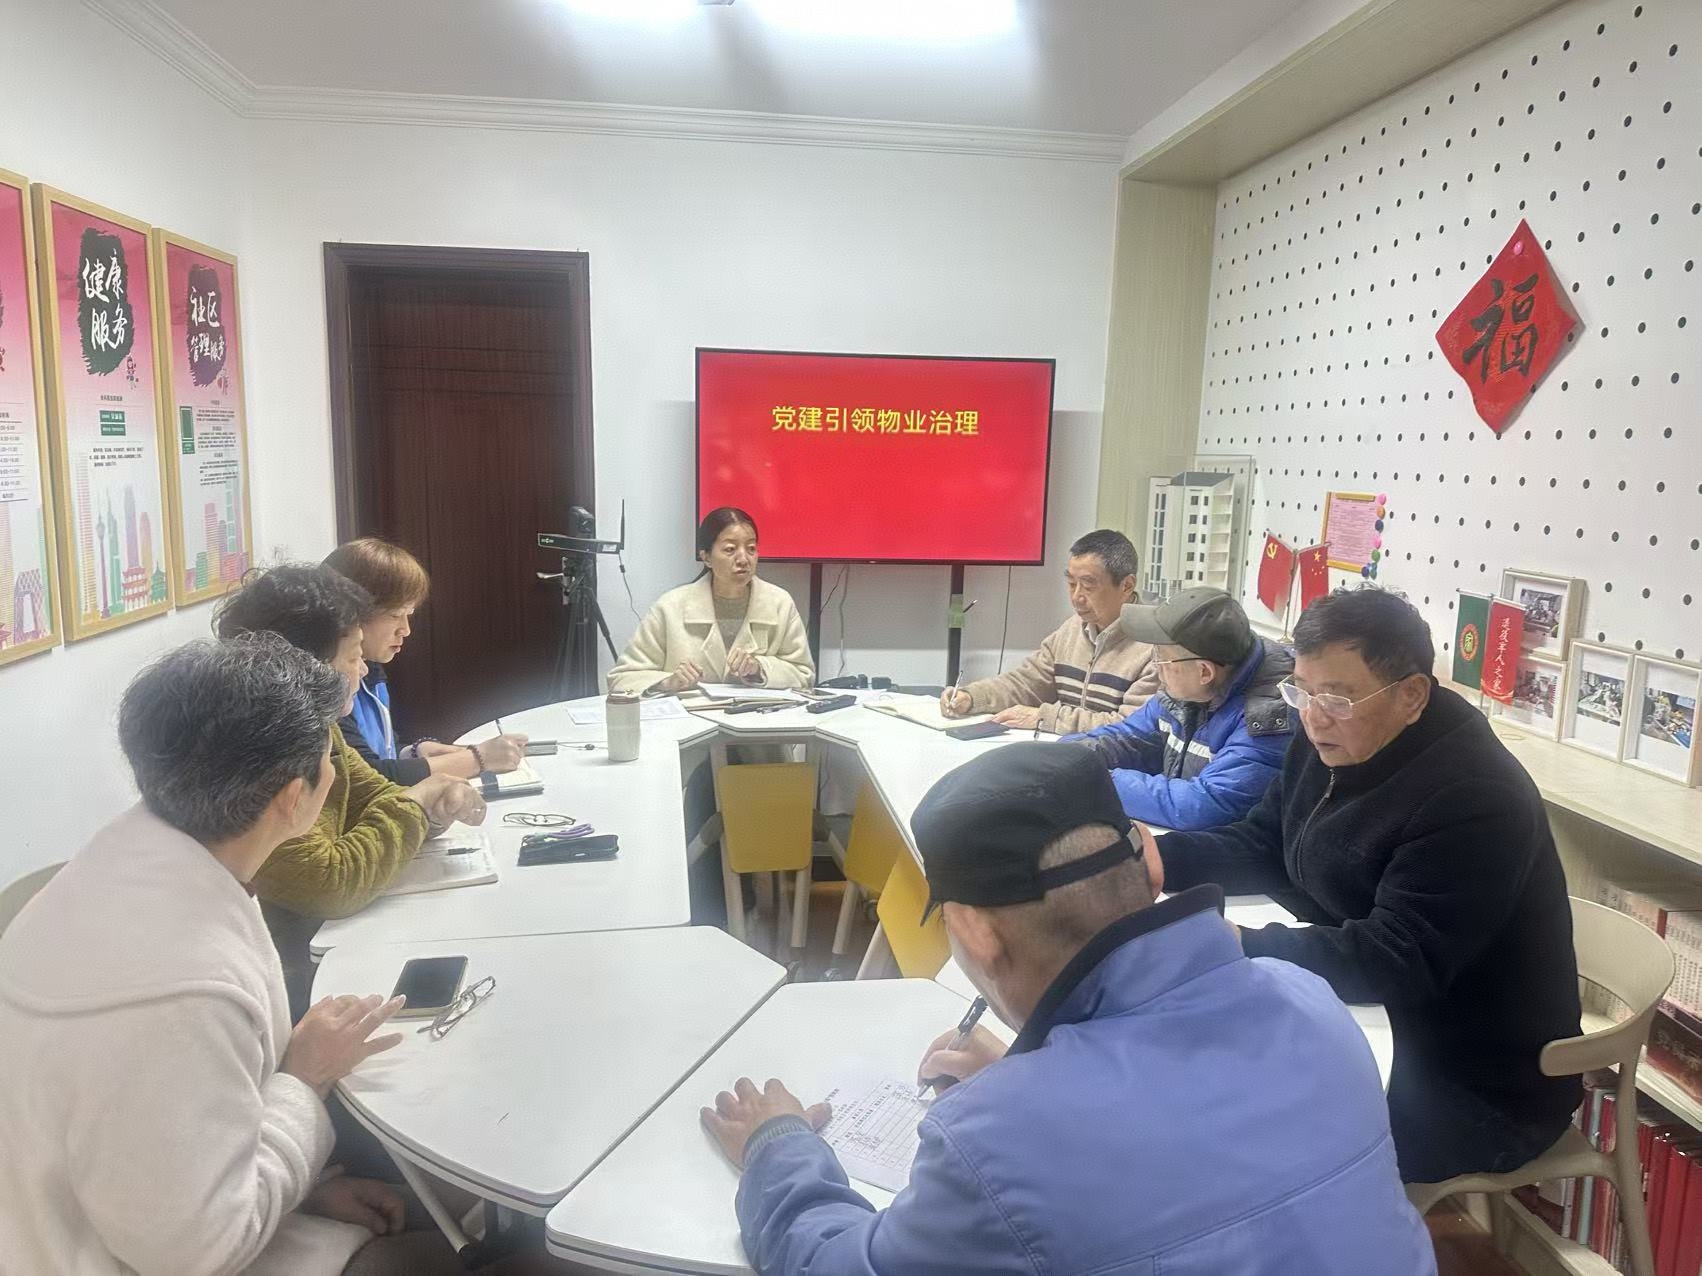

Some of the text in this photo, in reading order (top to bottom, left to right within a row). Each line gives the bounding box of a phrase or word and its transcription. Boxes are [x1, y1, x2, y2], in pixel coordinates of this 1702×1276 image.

[82, 249, 124, 303] 健康
[91, 303, 128, 352] 服务
[190, 286, 220, 328] 社区
[1463, 274, 1539, 384] 福
[190, 332, 225, 363] 管理服务
[772, 406, 979, 434] 党建引领物业治理
